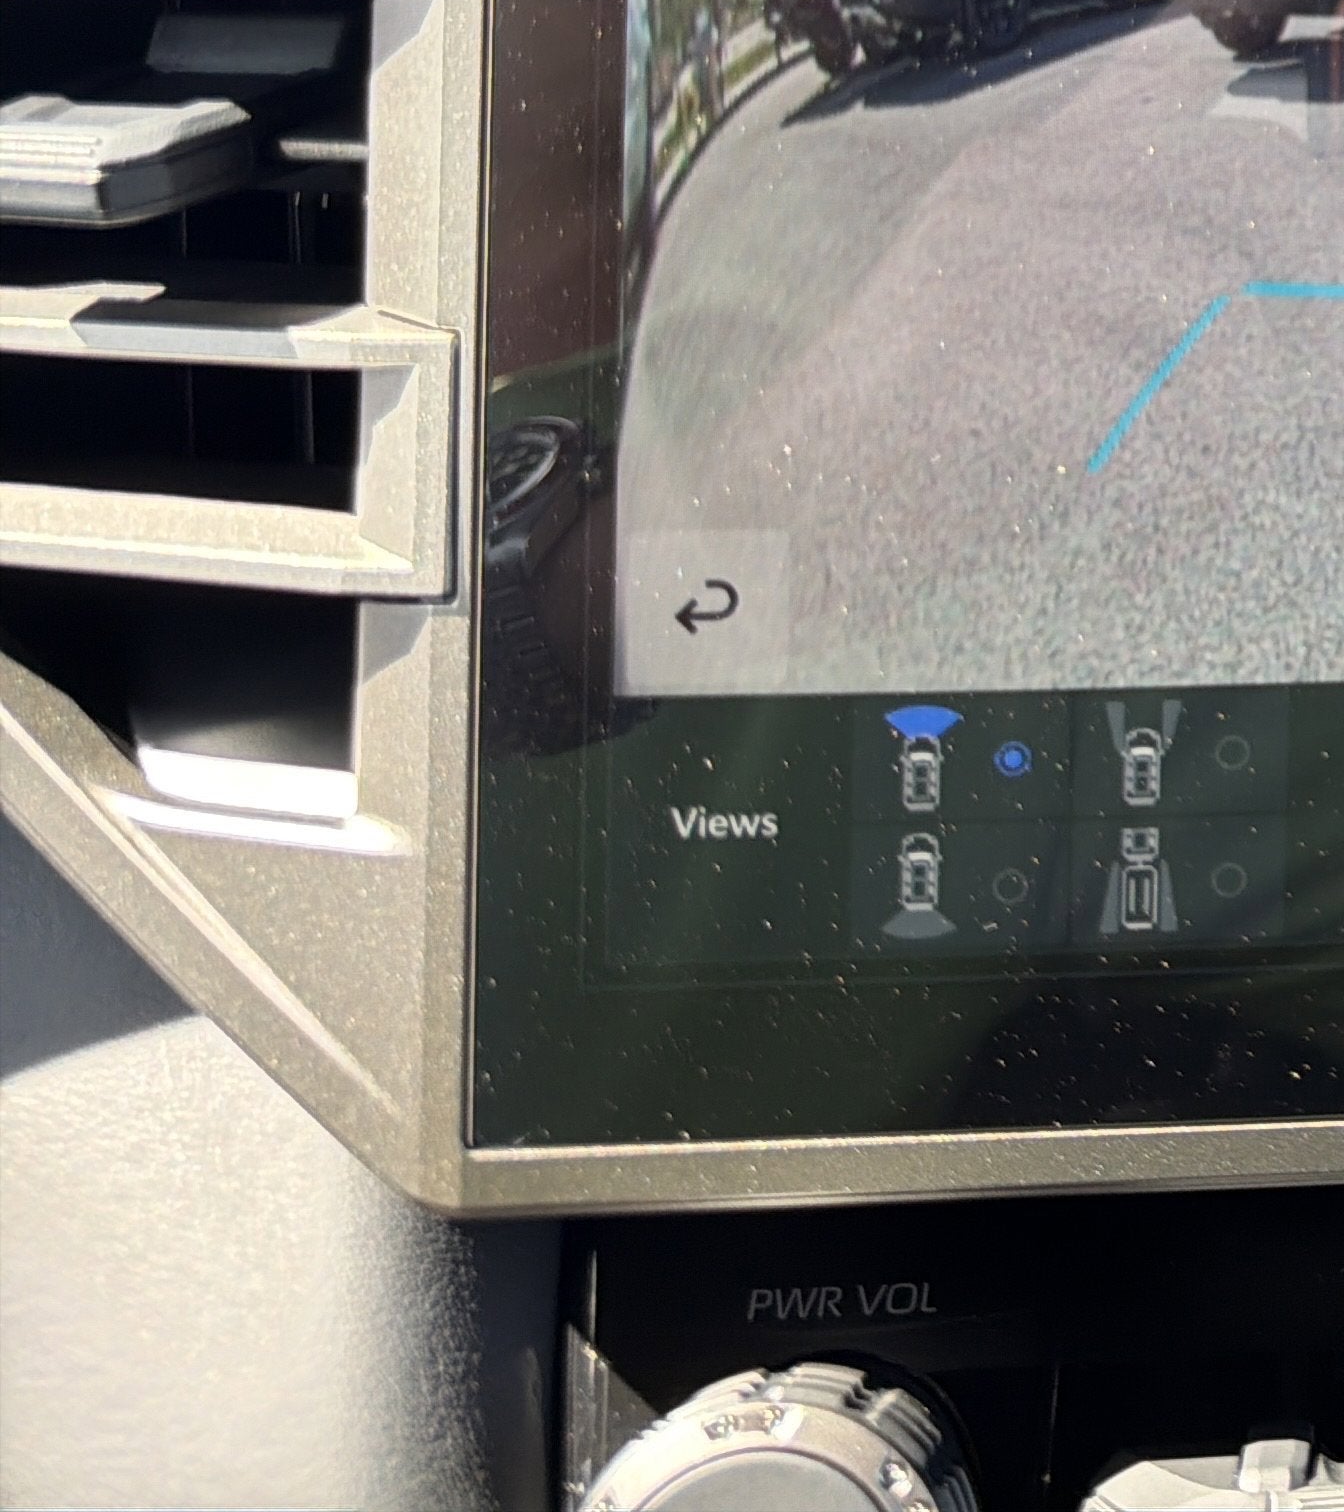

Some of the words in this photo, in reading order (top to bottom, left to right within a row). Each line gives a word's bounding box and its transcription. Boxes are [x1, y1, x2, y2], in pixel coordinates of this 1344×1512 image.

[669, 805, 779, 839] Views
[746, 1286, 843, 1322] PWR
[857, 1282, 938, 1317] VOL
